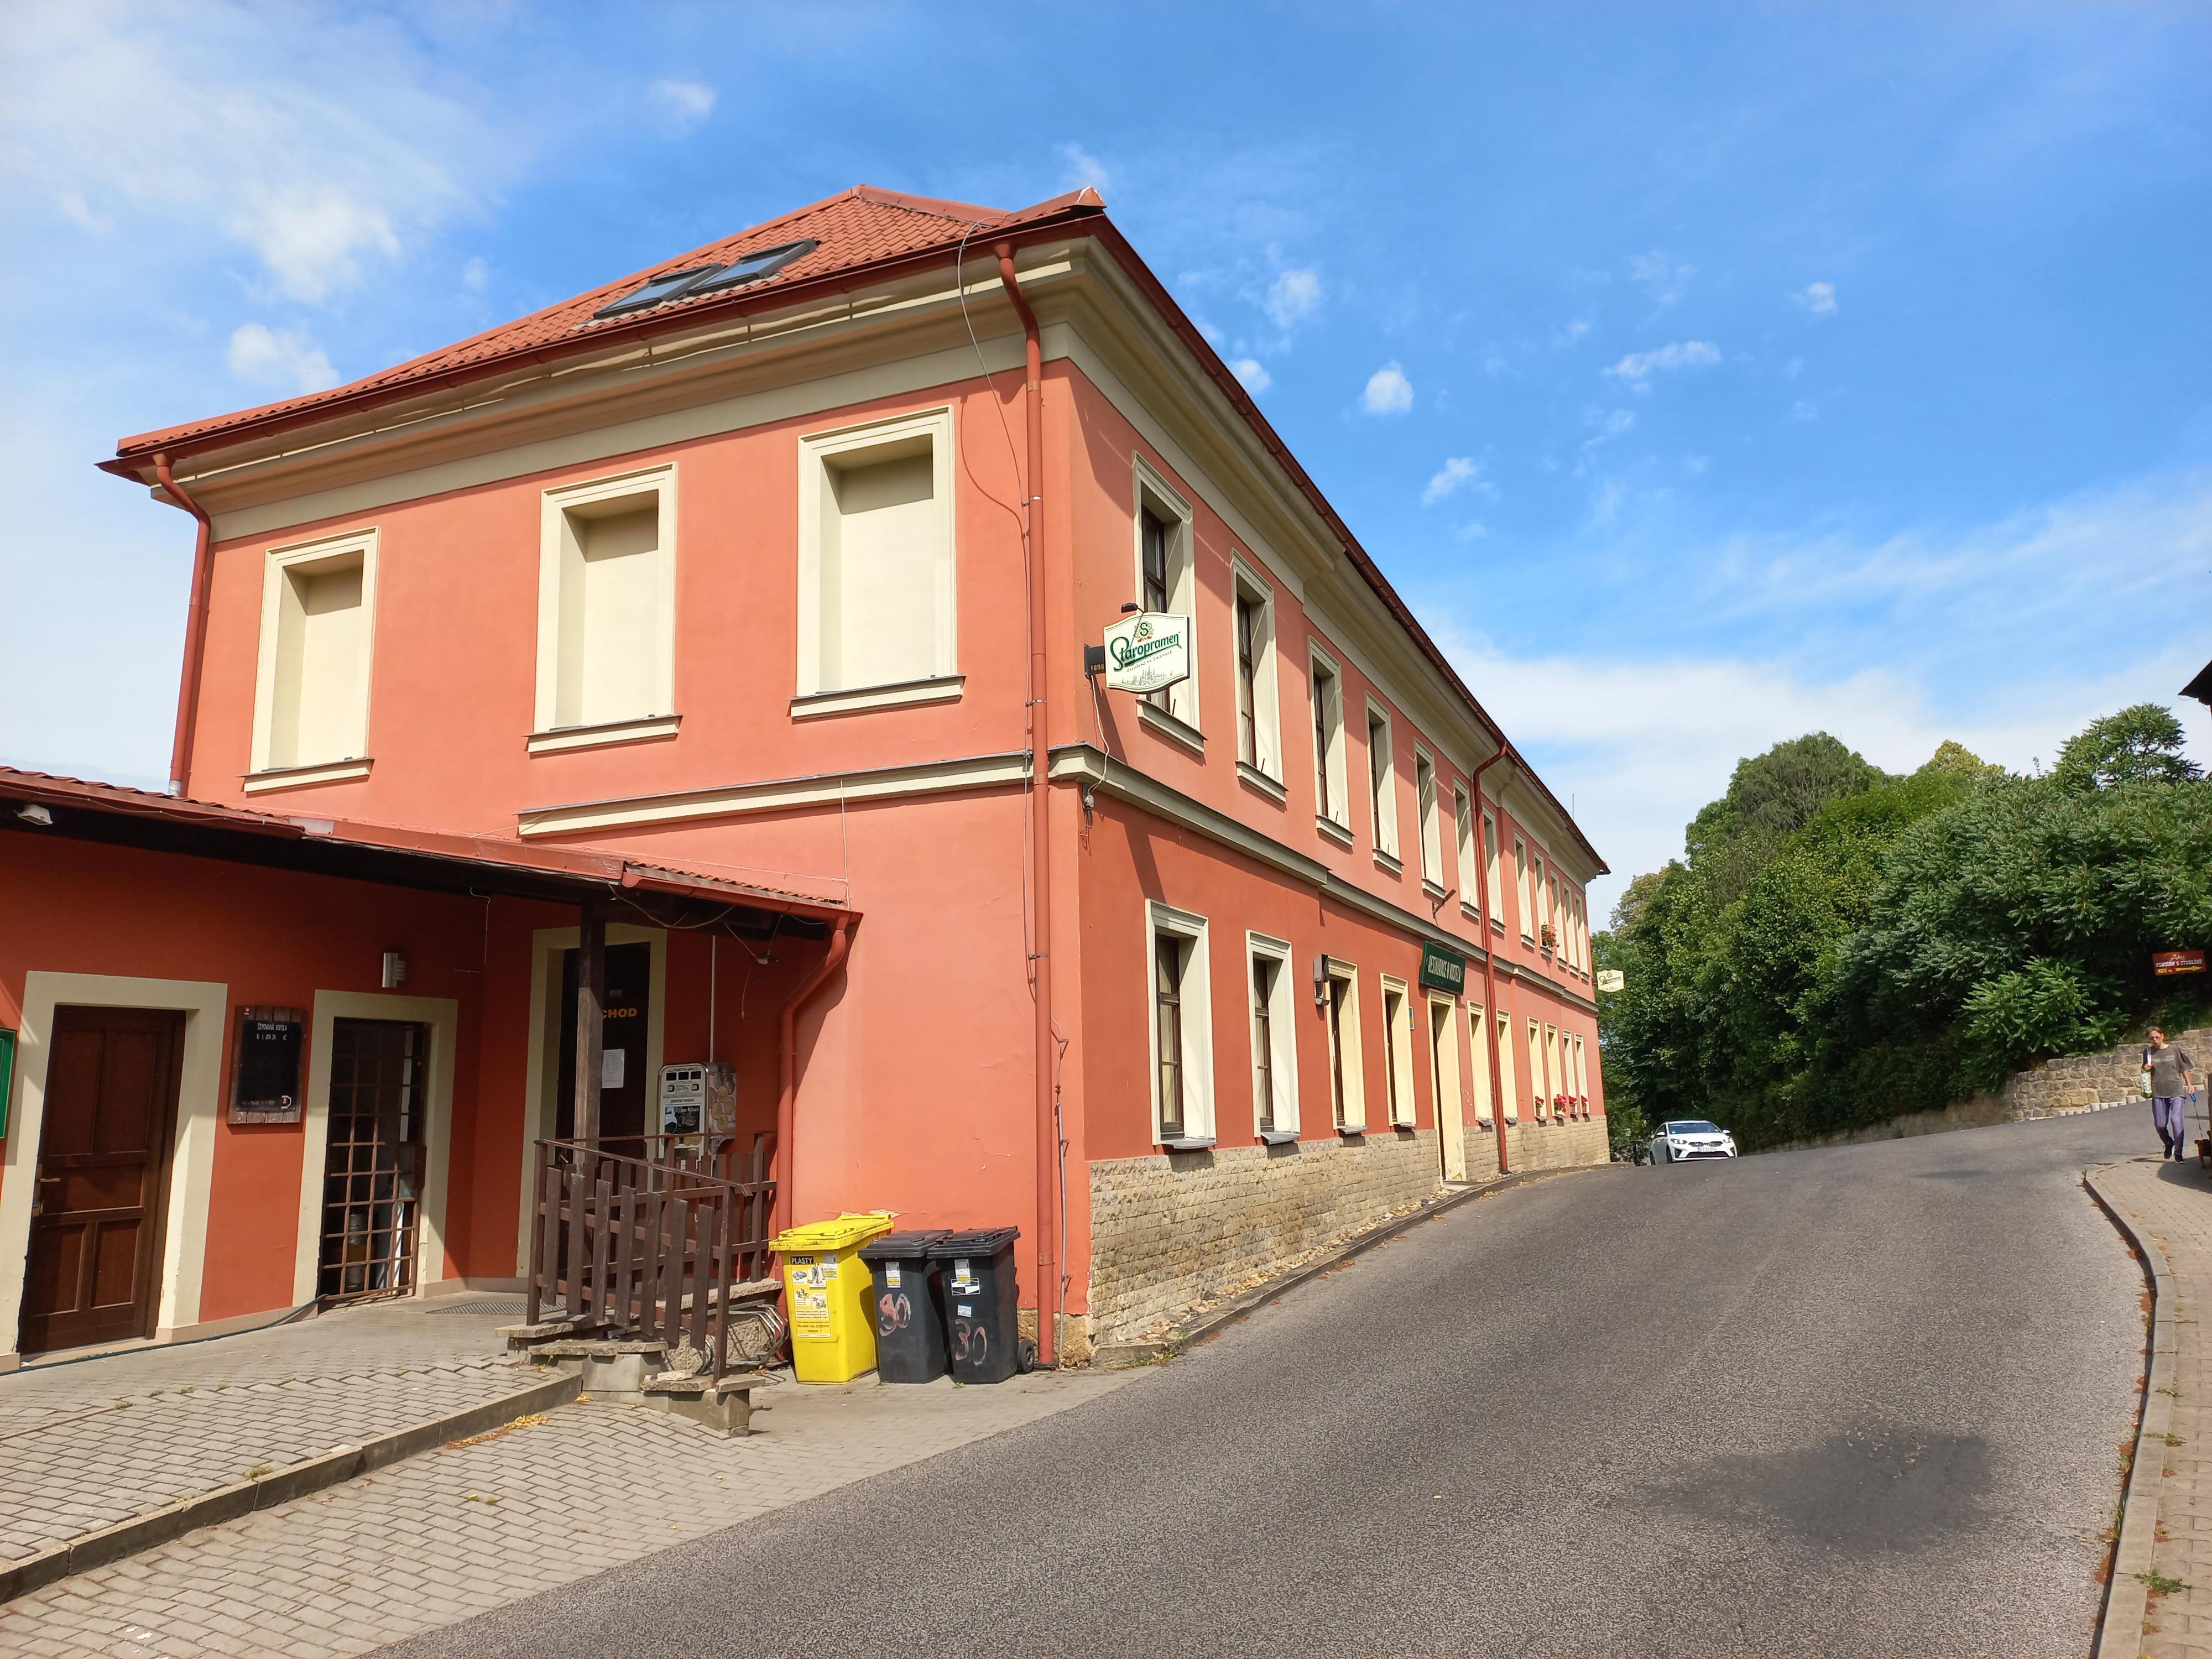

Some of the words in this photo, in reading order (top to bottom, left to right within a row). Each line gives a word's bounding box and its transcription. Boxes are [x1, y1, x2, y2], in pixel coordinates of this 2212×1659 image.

[1110, 633, 1180, 672] Staropramen
[602, 1008, 637, 1019] CHOD
[955, 1319, 987, 1366] 30
